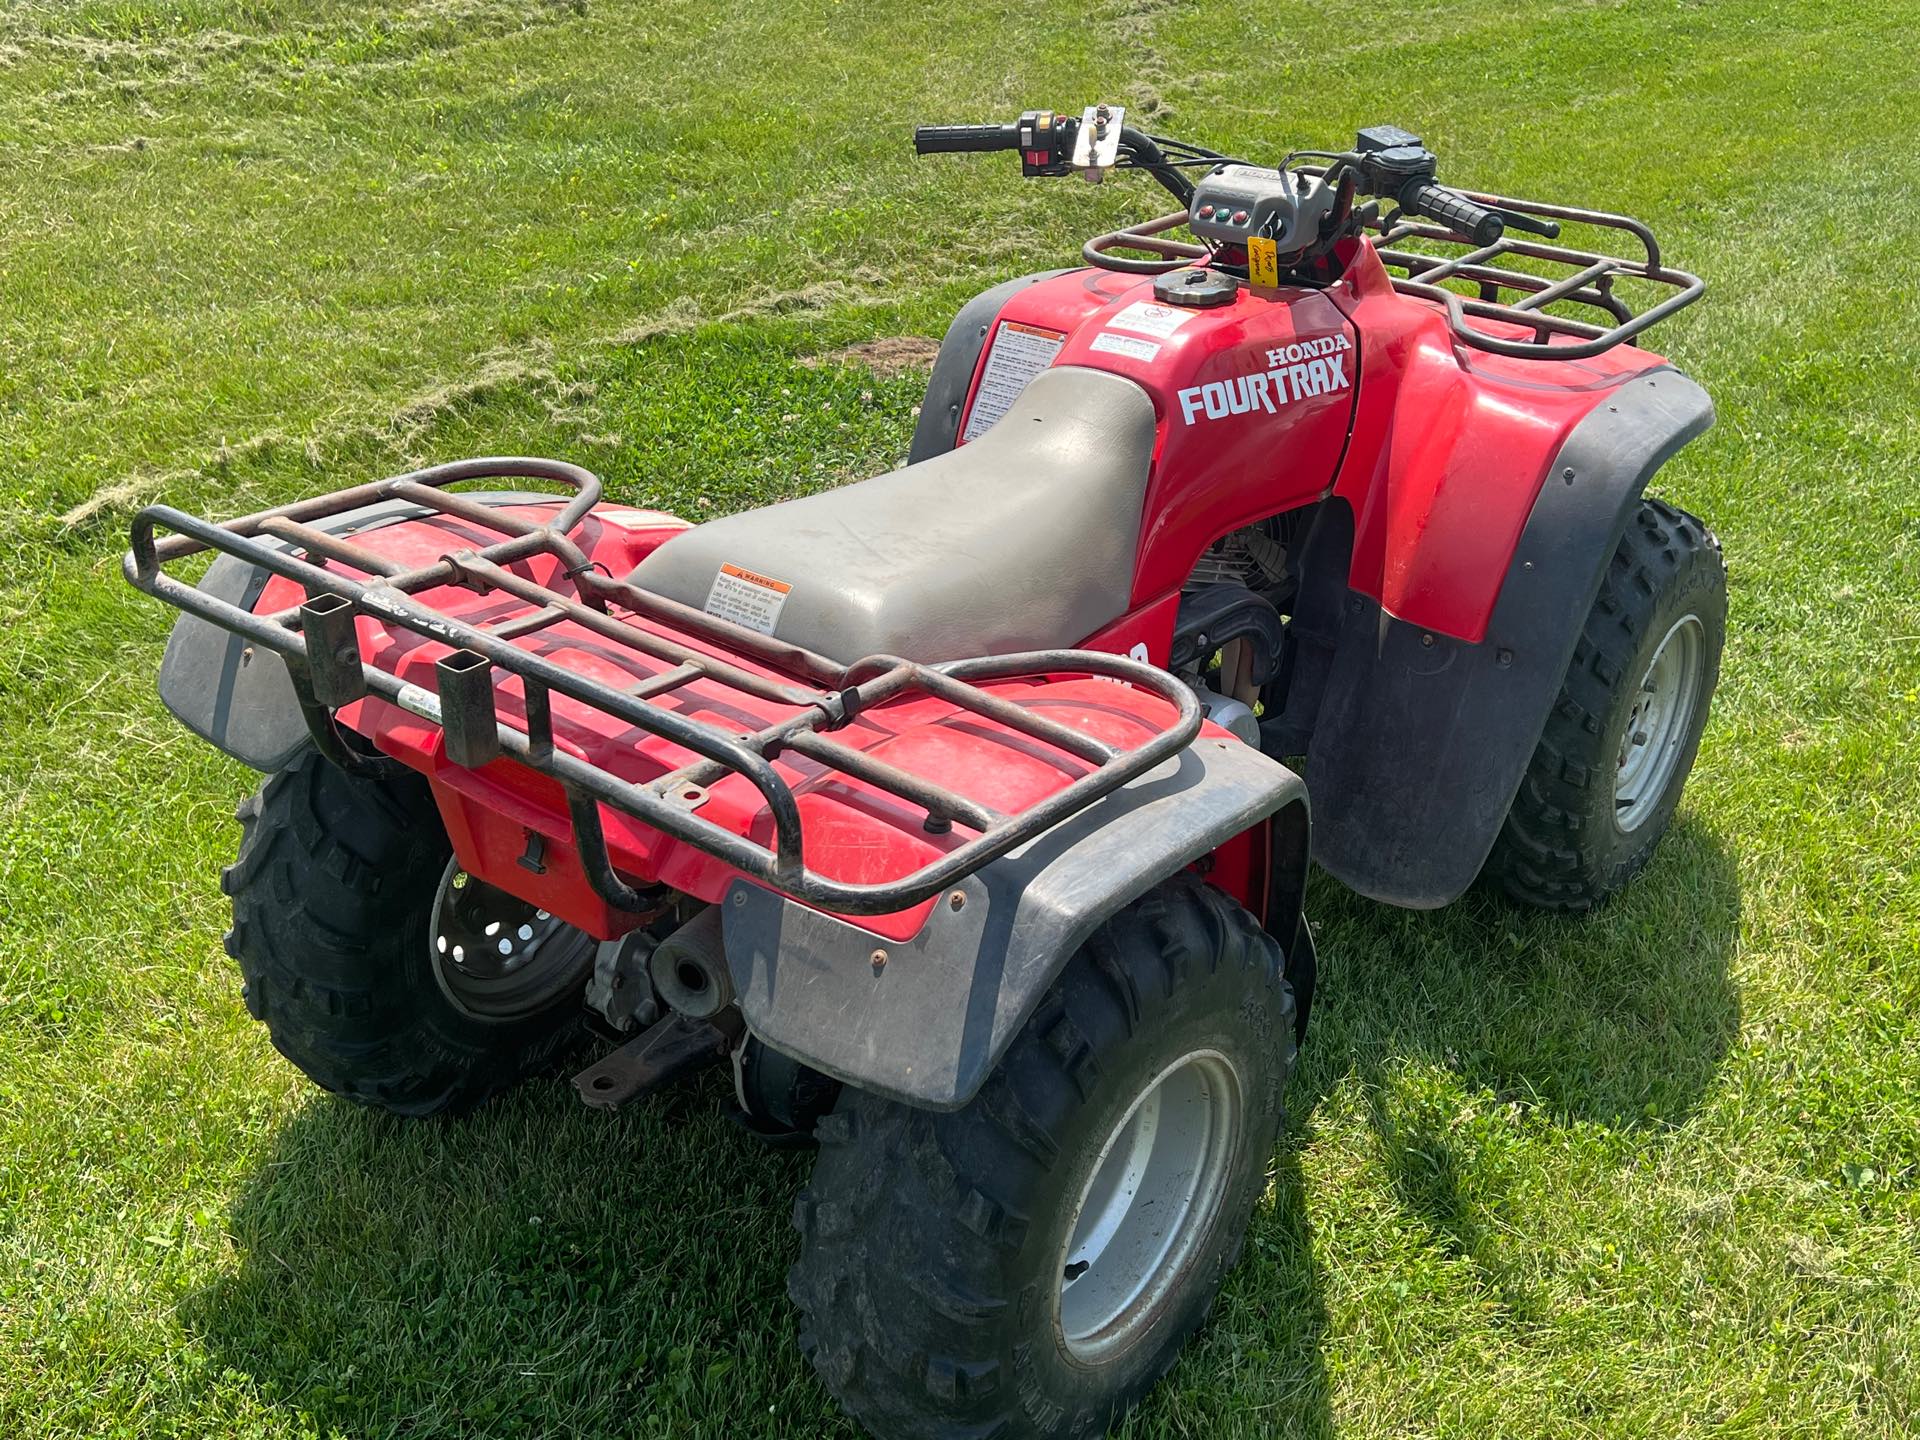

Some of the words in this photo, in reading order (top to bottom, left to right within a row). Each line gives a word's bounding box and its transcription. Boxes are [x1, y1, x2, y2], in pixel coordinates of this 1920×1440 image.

[1265, 333, 1352, 368] HONDA
[1177, 354, 1350, 426] FOURTRAX
[745, 573, 775, 588] WARNING
